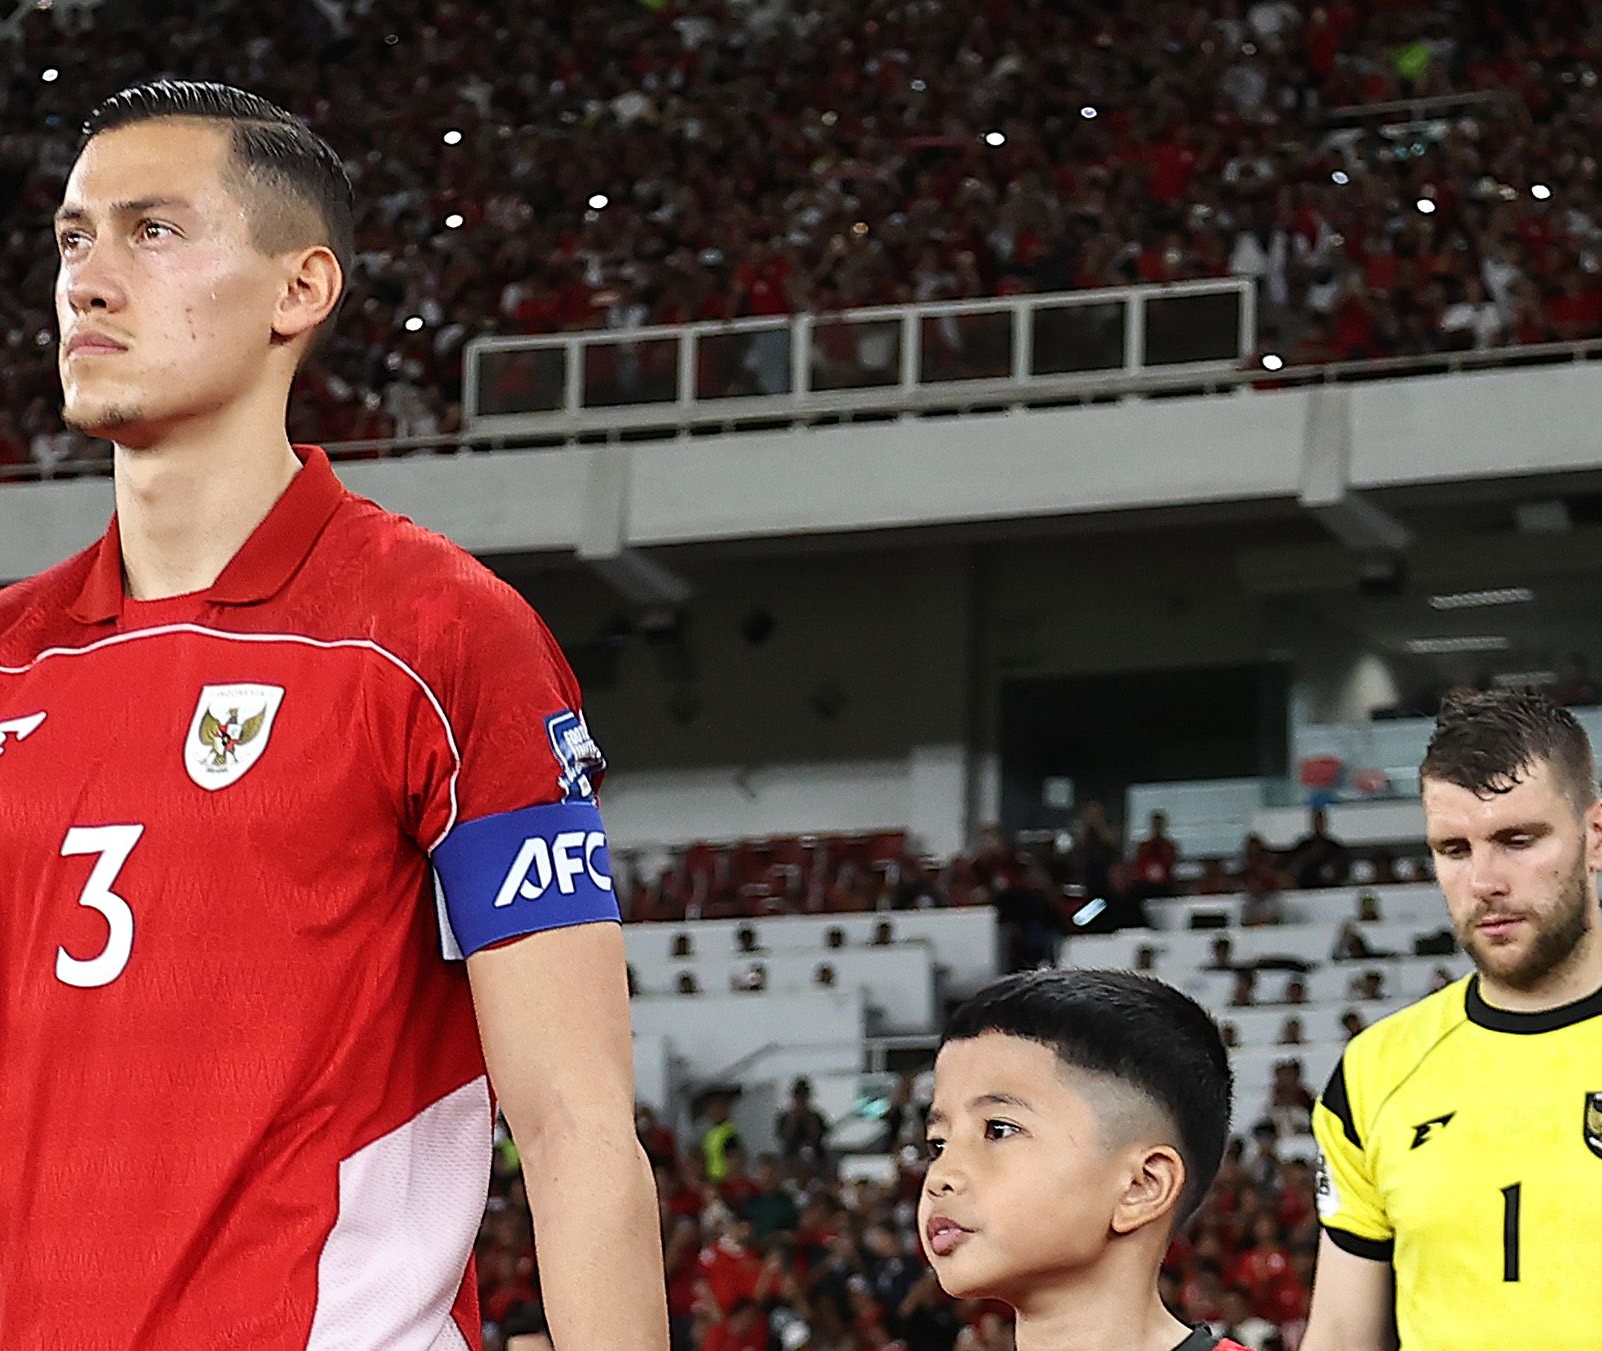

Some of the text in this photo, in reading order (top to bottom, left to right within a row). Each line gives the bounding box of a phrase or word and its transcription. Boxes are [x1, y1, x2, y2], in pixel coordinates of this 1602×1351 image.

[55, 823, 144, 987] 3
[493, 830, 612, 907] AFC
[1501, 1182, 1521, 1283] 1
